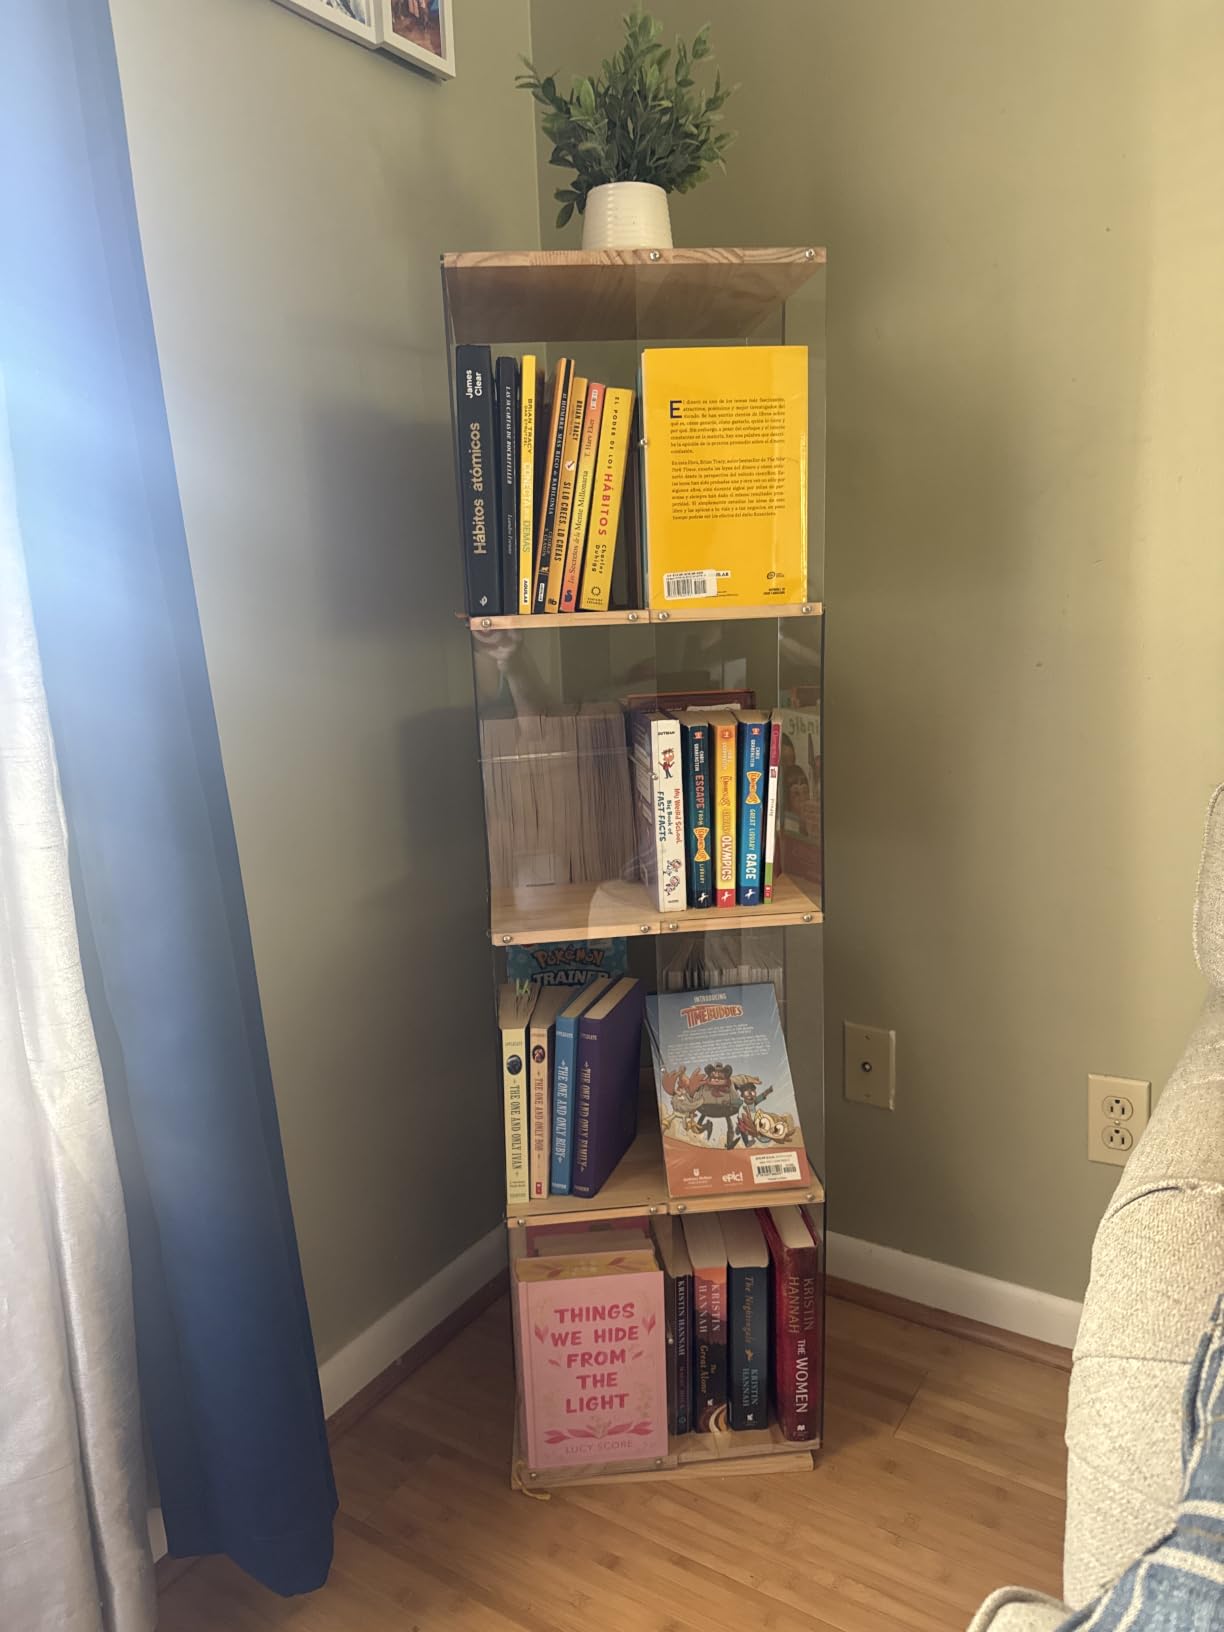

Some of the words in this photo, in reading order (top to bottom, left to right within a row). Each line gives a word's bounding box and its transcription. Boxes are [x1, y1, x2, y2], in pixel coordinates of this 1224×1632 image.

[465, 369, 473, 399] James
[474, 371, 482, 397] Clear
[575, 400, 583, 419] BRIAN
[614, 396, 620, 405] EL
[559, 400, 567, 430] HOMBRE
[610, 409, 618, 436] PODER
[572, 421, 581, 441] TRACY
[587, 419, 595, 433] Eker
[584, 436, 592, 450] Harv
[609, 440, 615, 450] DE
[468, 422, 483, 492] atómicos
[548, 478, 558, 515] BABILONIA
[562, 491, 570, 500] LO
[577, 470, 588, 508] Millonaria
[598, 473, 613, 536] HÁBITOS
[473, 498, 487, 555] Hábitos
[574, 508, 584, 530] Mente
[557, 528, 566, 538] LO
[554, 539, 564, 562] CREAS
[568, 546, 578, 574] Secretos
[592, 544, 600, 572] Duhigg
[599, 544, 607, 574] Charles
[657, 792, 665, 812] FAST
[673, 788, 681, 799] My
[694, 774, 705, 809] ESCAPE
[658, 815, 666, 842] FACTS
[748, 828, 756, 850] LIBRARY
[722, 836, 732, 880] OLYMPICS
[746, 853, 758, 880] RACE
[534, 1078, 544, 1090] THE
[558, 1066, 568, 1082] THE
[581, 1068, 591, 1084] THE
[510, 1084, 520, 1100] THE
[534, 1092, 544, 1104] ONE
[558, 1082, 568, 1098] ONE
[581, 1085, 590, 1100] ONE
[510, 1101, 520, 1115] ONE
[534, 1106, 544, 1120] AND
[556, 1100, 568, 1116] AND
[580, 1102, 590, 1117] AND
[511, 1117, 521, 1132] AND
[534, 1121, 544, 1138] ONLY
[556, 1116, 567, 1136] ONLY
[579, 1118, 590, 1138] ONLY
[512, 1134, 522, 1151] ONLY
[555, 1137, 566, 1158] RUBY
[512, 1152, 522, 1170] IVAN
[578, 1140, 588, 1168] FAMILY
[722, 1170, 744, 1183] epic!
[744, 1276, 754, 1292] The
[554, 1302, 635, 1324] THINGS
[699, 1284, 708, 1333] HANNAH
[711, 1284, 720, 1332] KRISTIN
[788, 1276, 801, 1334] HANNAH
[802, 1278, 815, 1331] KRISTIN
[550, 1330, 583, 1348] WE
[594, 1325, 639, 1344] HIDE
[797, 1340, 806, 1354] THE
[566, 1348, 626, 1369] FROM
[699, 1344, 709, 1368] Great
[576, 1371, 618, 1390] THE
[700, 1371, 710, 1394] Alone
[742, 1368, 750, 1407] HANNAH
[795, 1357, 808, 1413] WOMEN
[565, 1393, 630, 1414] LIGHT
[598, 1439, 633, 1451] SCORE
